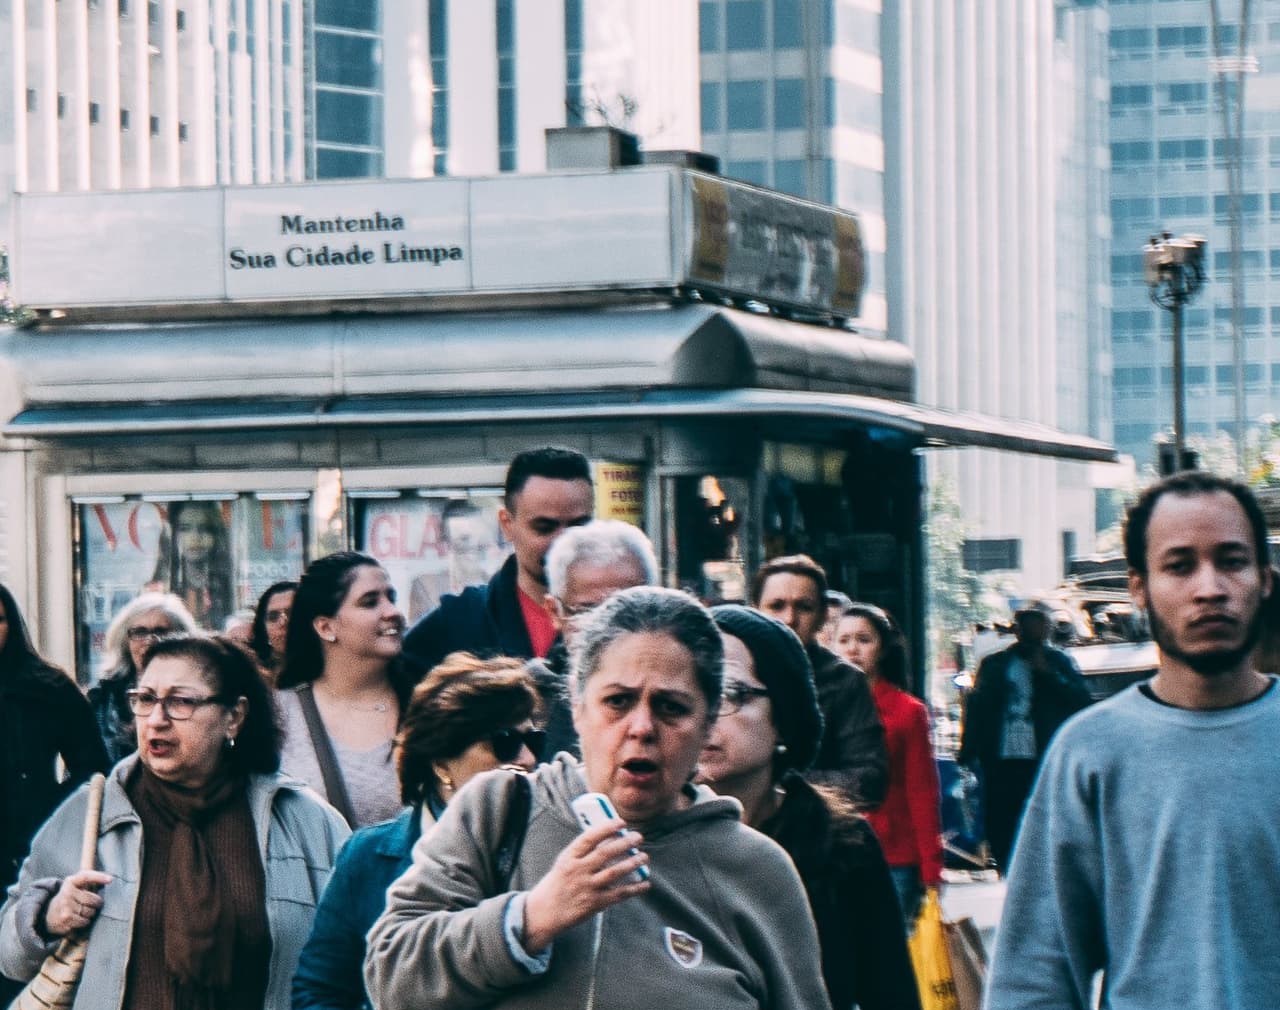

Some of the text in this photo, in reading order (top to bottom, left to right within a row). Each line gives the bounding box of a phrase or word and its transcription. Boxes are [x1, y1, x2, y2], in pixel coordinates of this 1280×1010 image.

[280, 211, 406, 235] Mantenha
[229, 243, 463, 269] Sua Cidade Limpa
